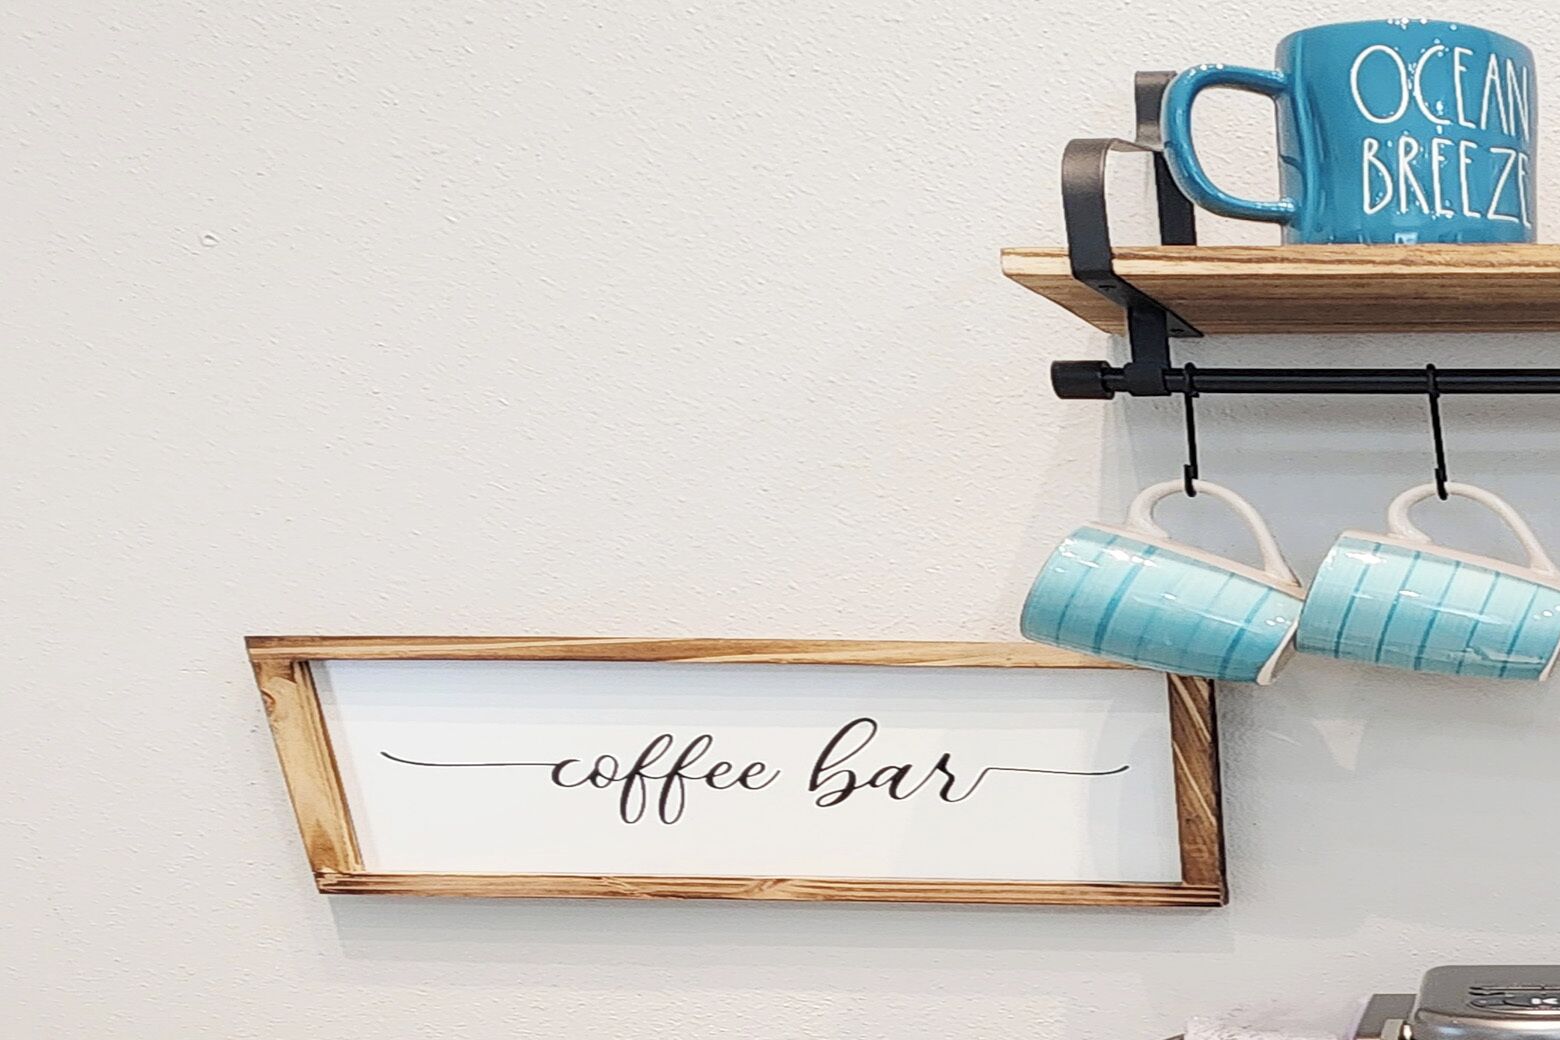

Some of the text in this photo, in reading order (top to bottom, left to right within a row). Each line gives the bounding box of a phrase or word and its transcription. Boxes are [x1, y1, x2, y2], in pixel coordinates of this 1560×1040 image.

[1350, 43, 1530, 143] OCEAN
[1362, 135, 1532, 230] BREEZE
[550, 717, 992, 824] coffee bar
